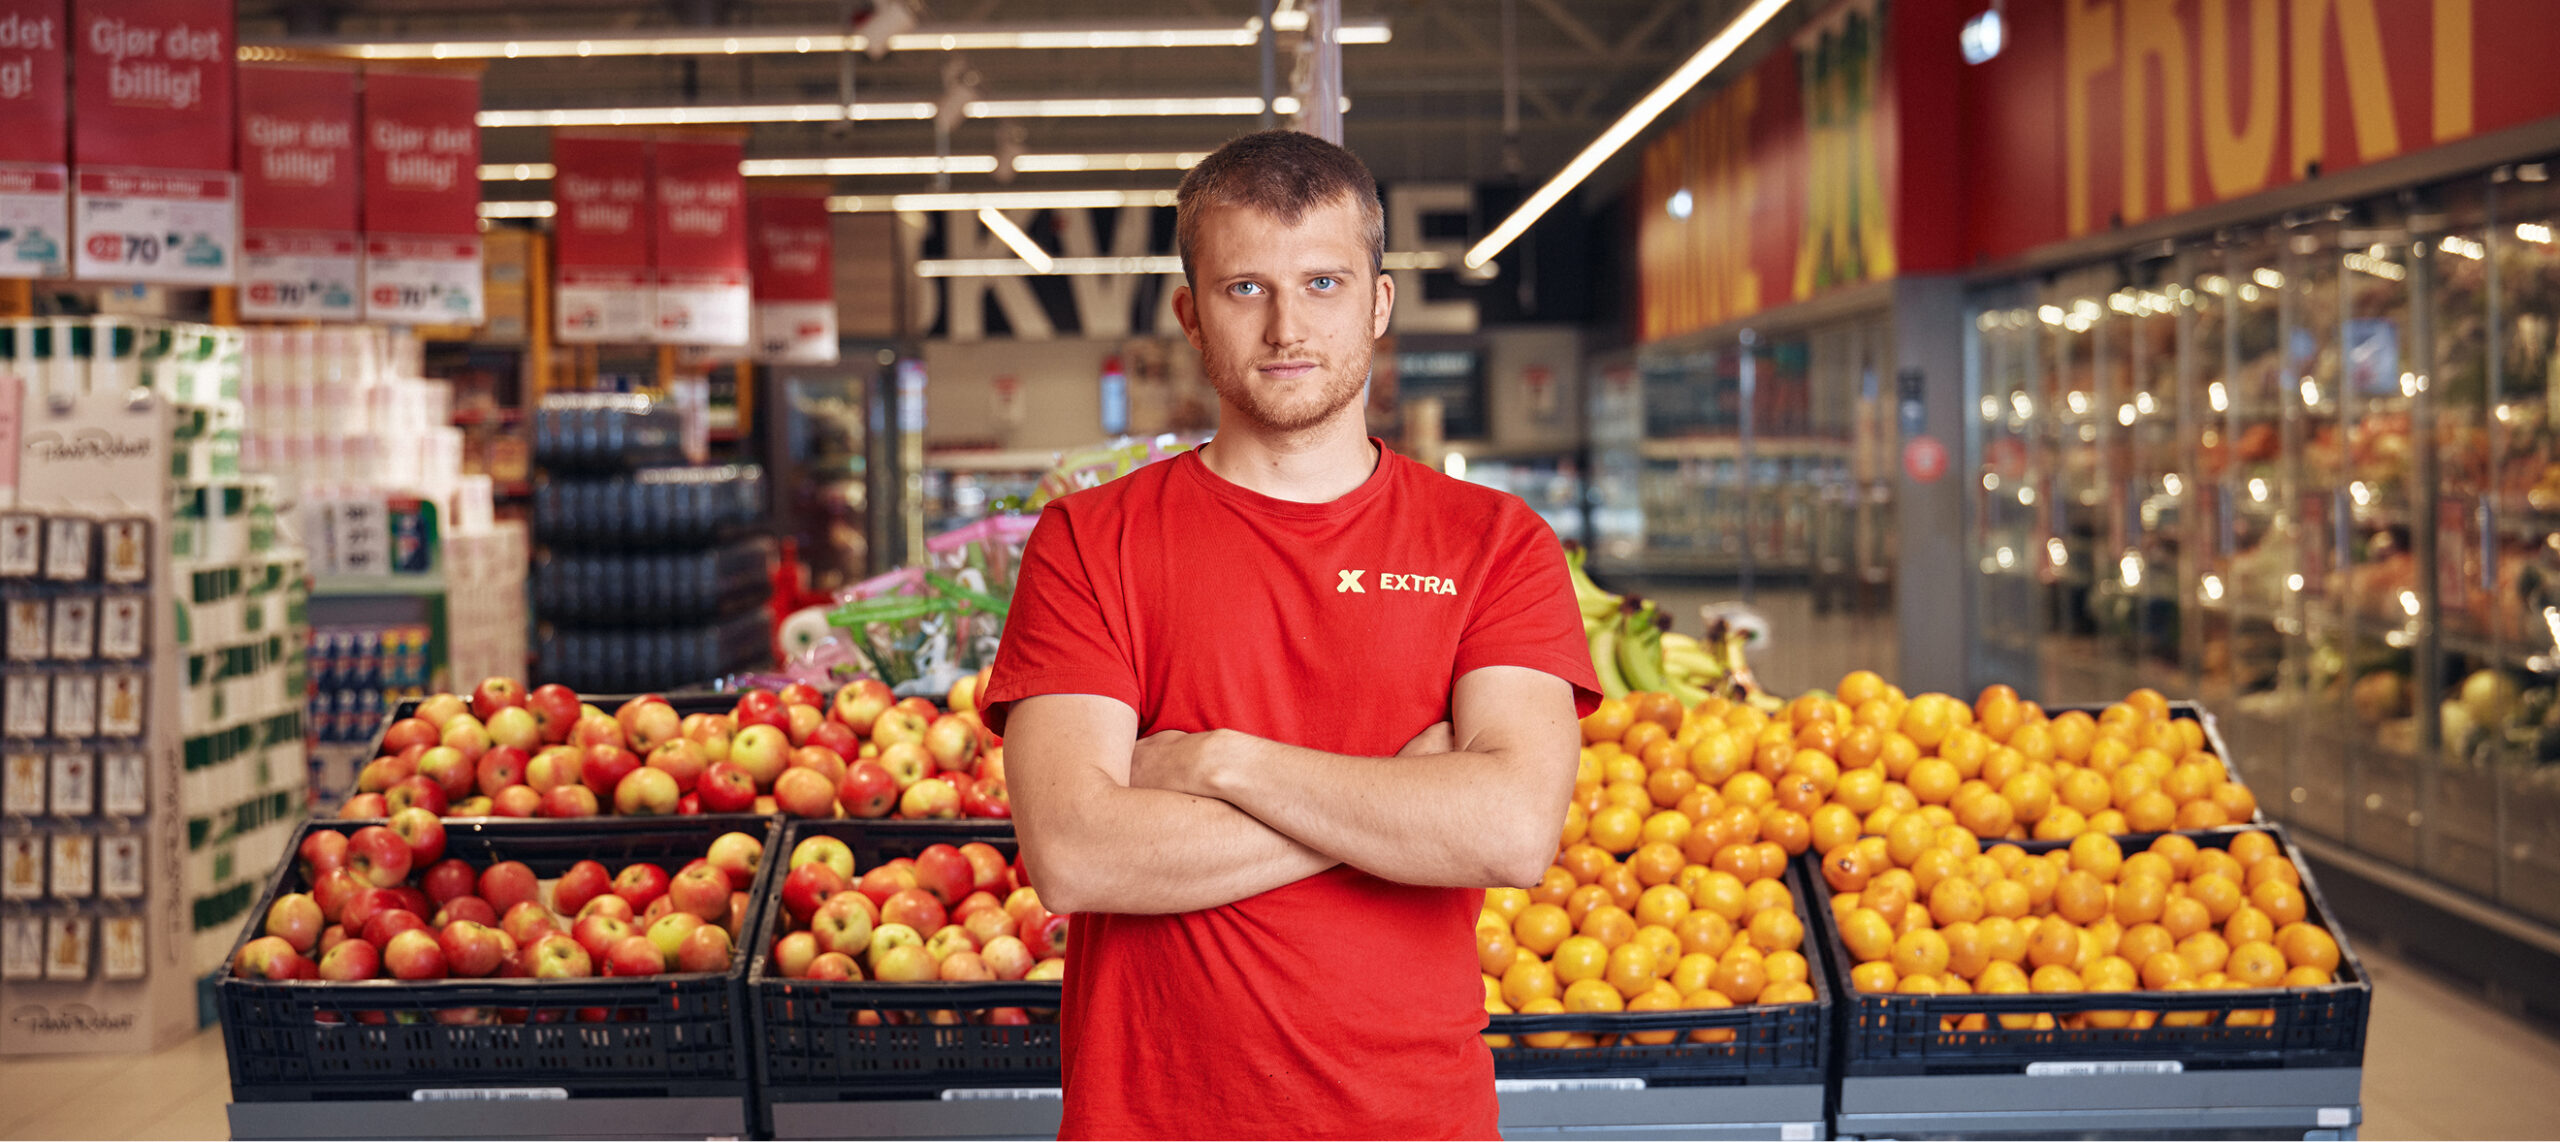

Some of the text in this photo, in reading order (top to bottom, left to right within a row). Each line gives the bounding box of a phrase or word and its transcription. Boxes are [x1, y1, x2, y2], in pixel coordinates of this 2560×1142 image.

[0, 13, 54, 49] det
[91, 18, 222, 62] Gjør det
[110, 62, 201, 108] billig!
[125, 233, 160, 265] 70
[1336, 569, 1458, 596] X EXTRA
